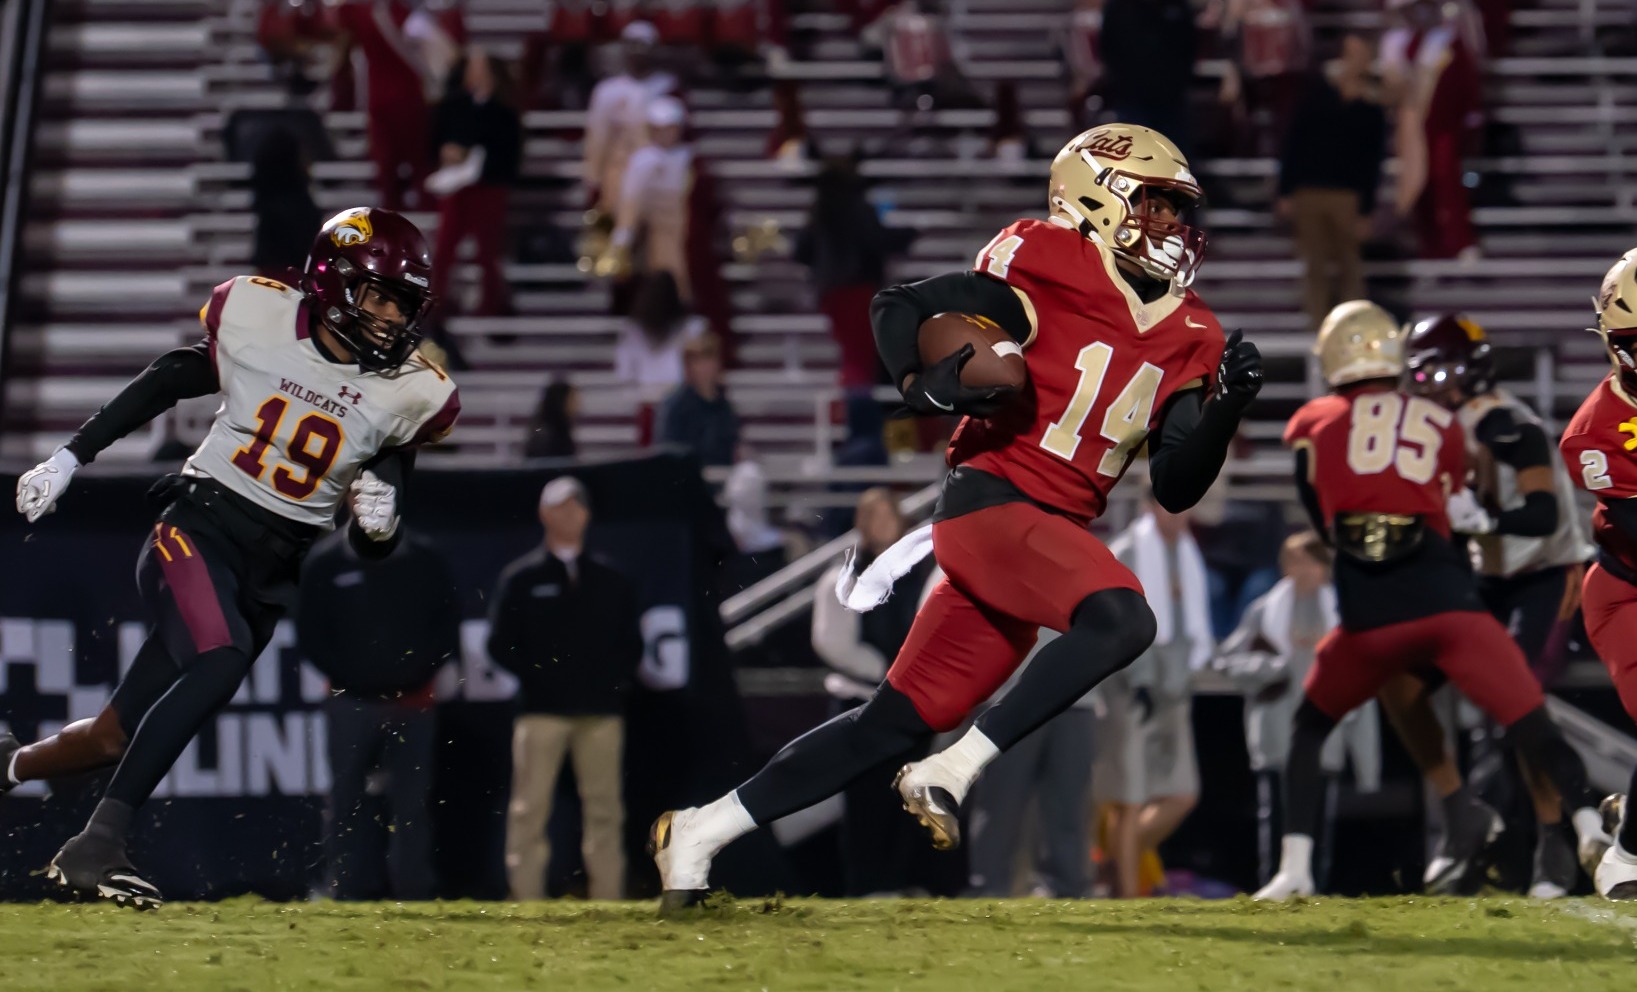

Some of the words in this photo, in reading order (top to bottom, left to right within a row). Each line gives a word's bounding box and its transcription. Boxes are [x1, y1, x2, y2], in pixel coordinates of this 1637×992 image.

[281, 377, 348, 418] WILDCATS
[1039, 340, 1165, 478] 14
[1346, 391, 1454, 485] 85
[231, 394, 344, 502] 19
[1580, 449, 1613, 490] 2
